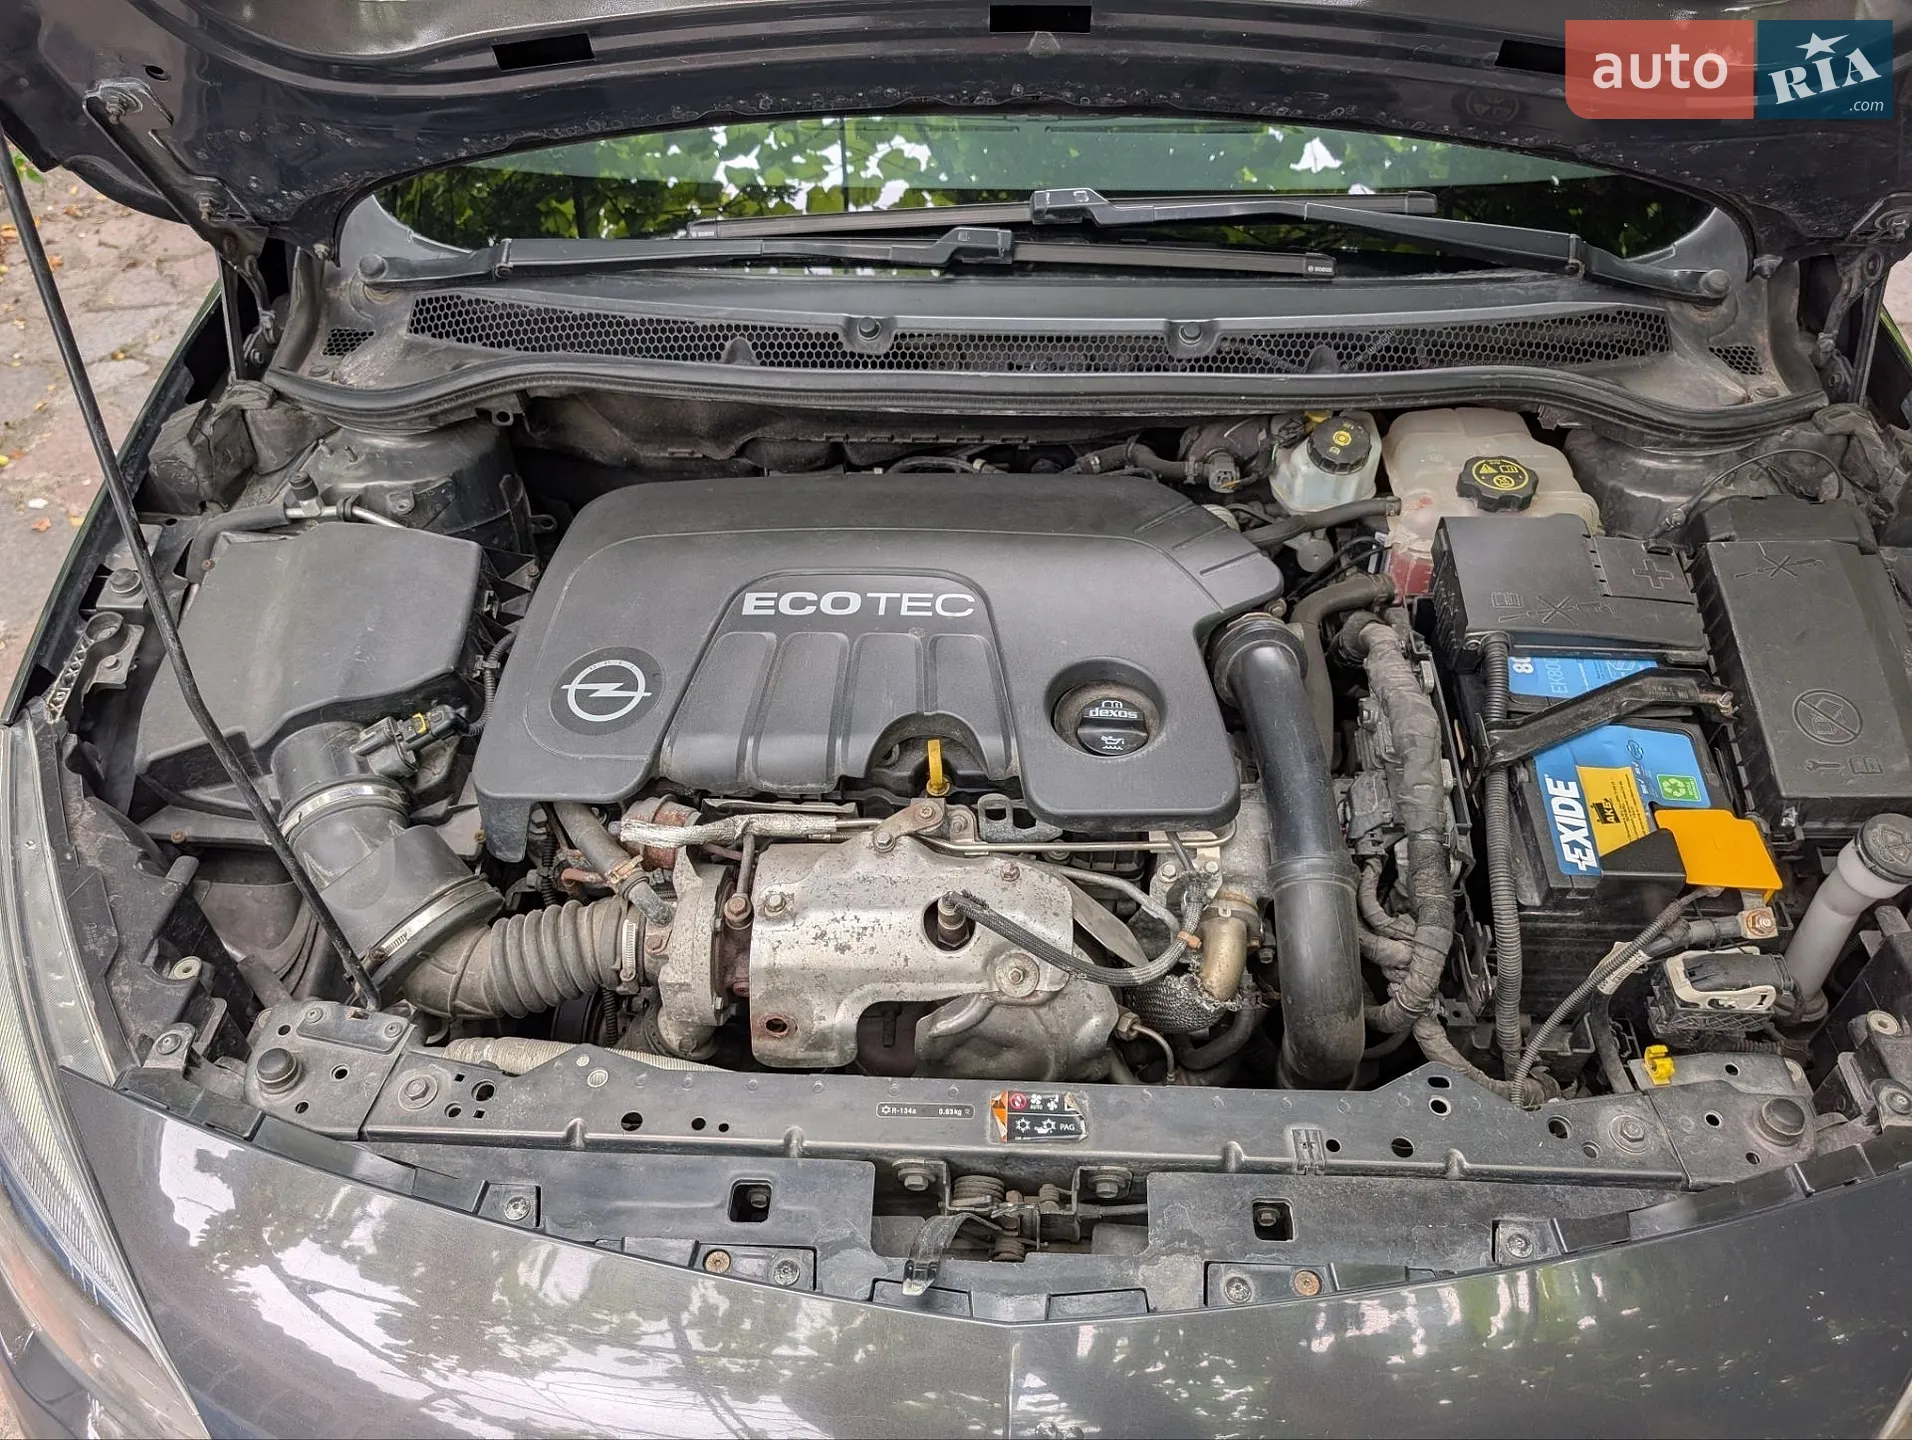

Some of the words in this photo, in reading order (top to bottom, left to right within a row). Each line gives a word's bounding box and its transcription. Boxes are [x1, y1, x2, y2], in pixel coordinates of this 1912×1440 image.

[742, 591, 976, 617] ECOTEC
[1089, 707, 1139, 719] dexos
[1546, 777, 1598, 871] EXIDE
[1060, 1123, 1075, 1131] PAG
